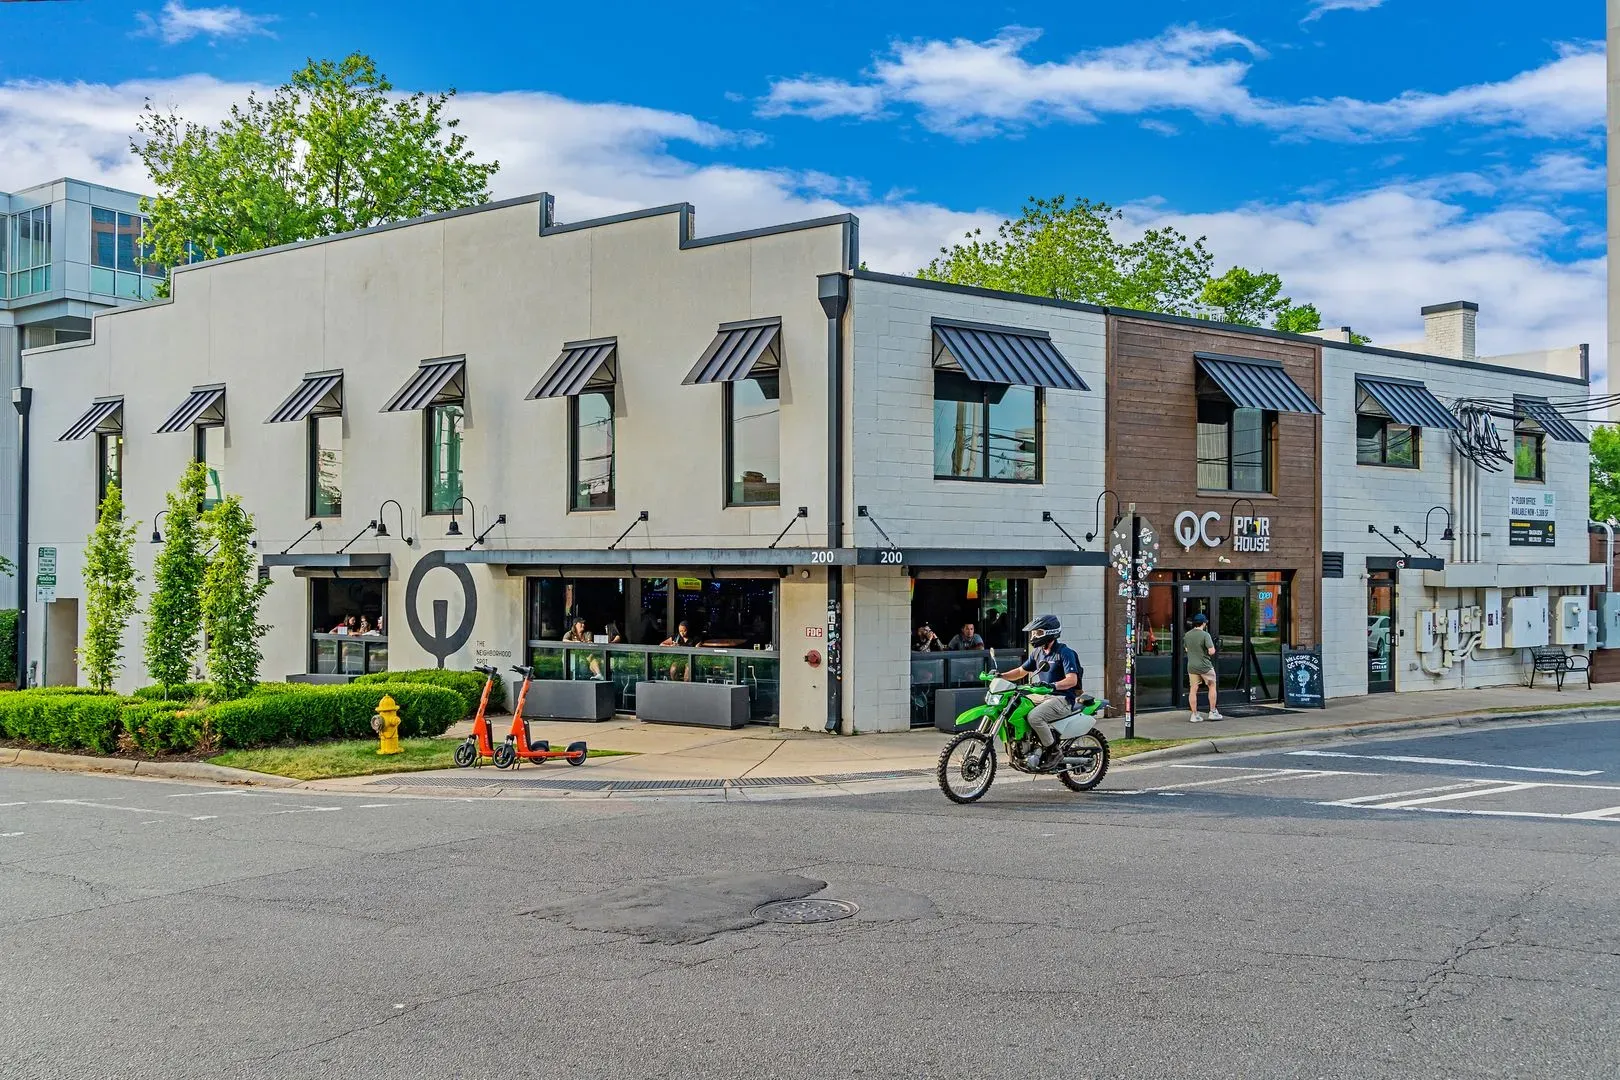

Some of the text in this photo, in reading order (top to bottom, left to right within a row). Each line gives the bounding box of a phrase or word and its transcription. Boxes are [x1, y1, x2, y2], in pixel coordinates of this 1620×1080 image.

[1516, 496, 1526, 504] FLOOR
[1526, 497, 1536, 505] OFFICE
[1512, 508, 1527, 516] AVAILABLE
[1174, 510, 1220, 552] QC
[1234, 536, 1270, 552] HOUSE
[812, 551, 834, 563] 200
[880, 552, 903, 563] 200
[807, 628, 822, 636] FDC
[1285, 655, 1310, 663] WELCOME
